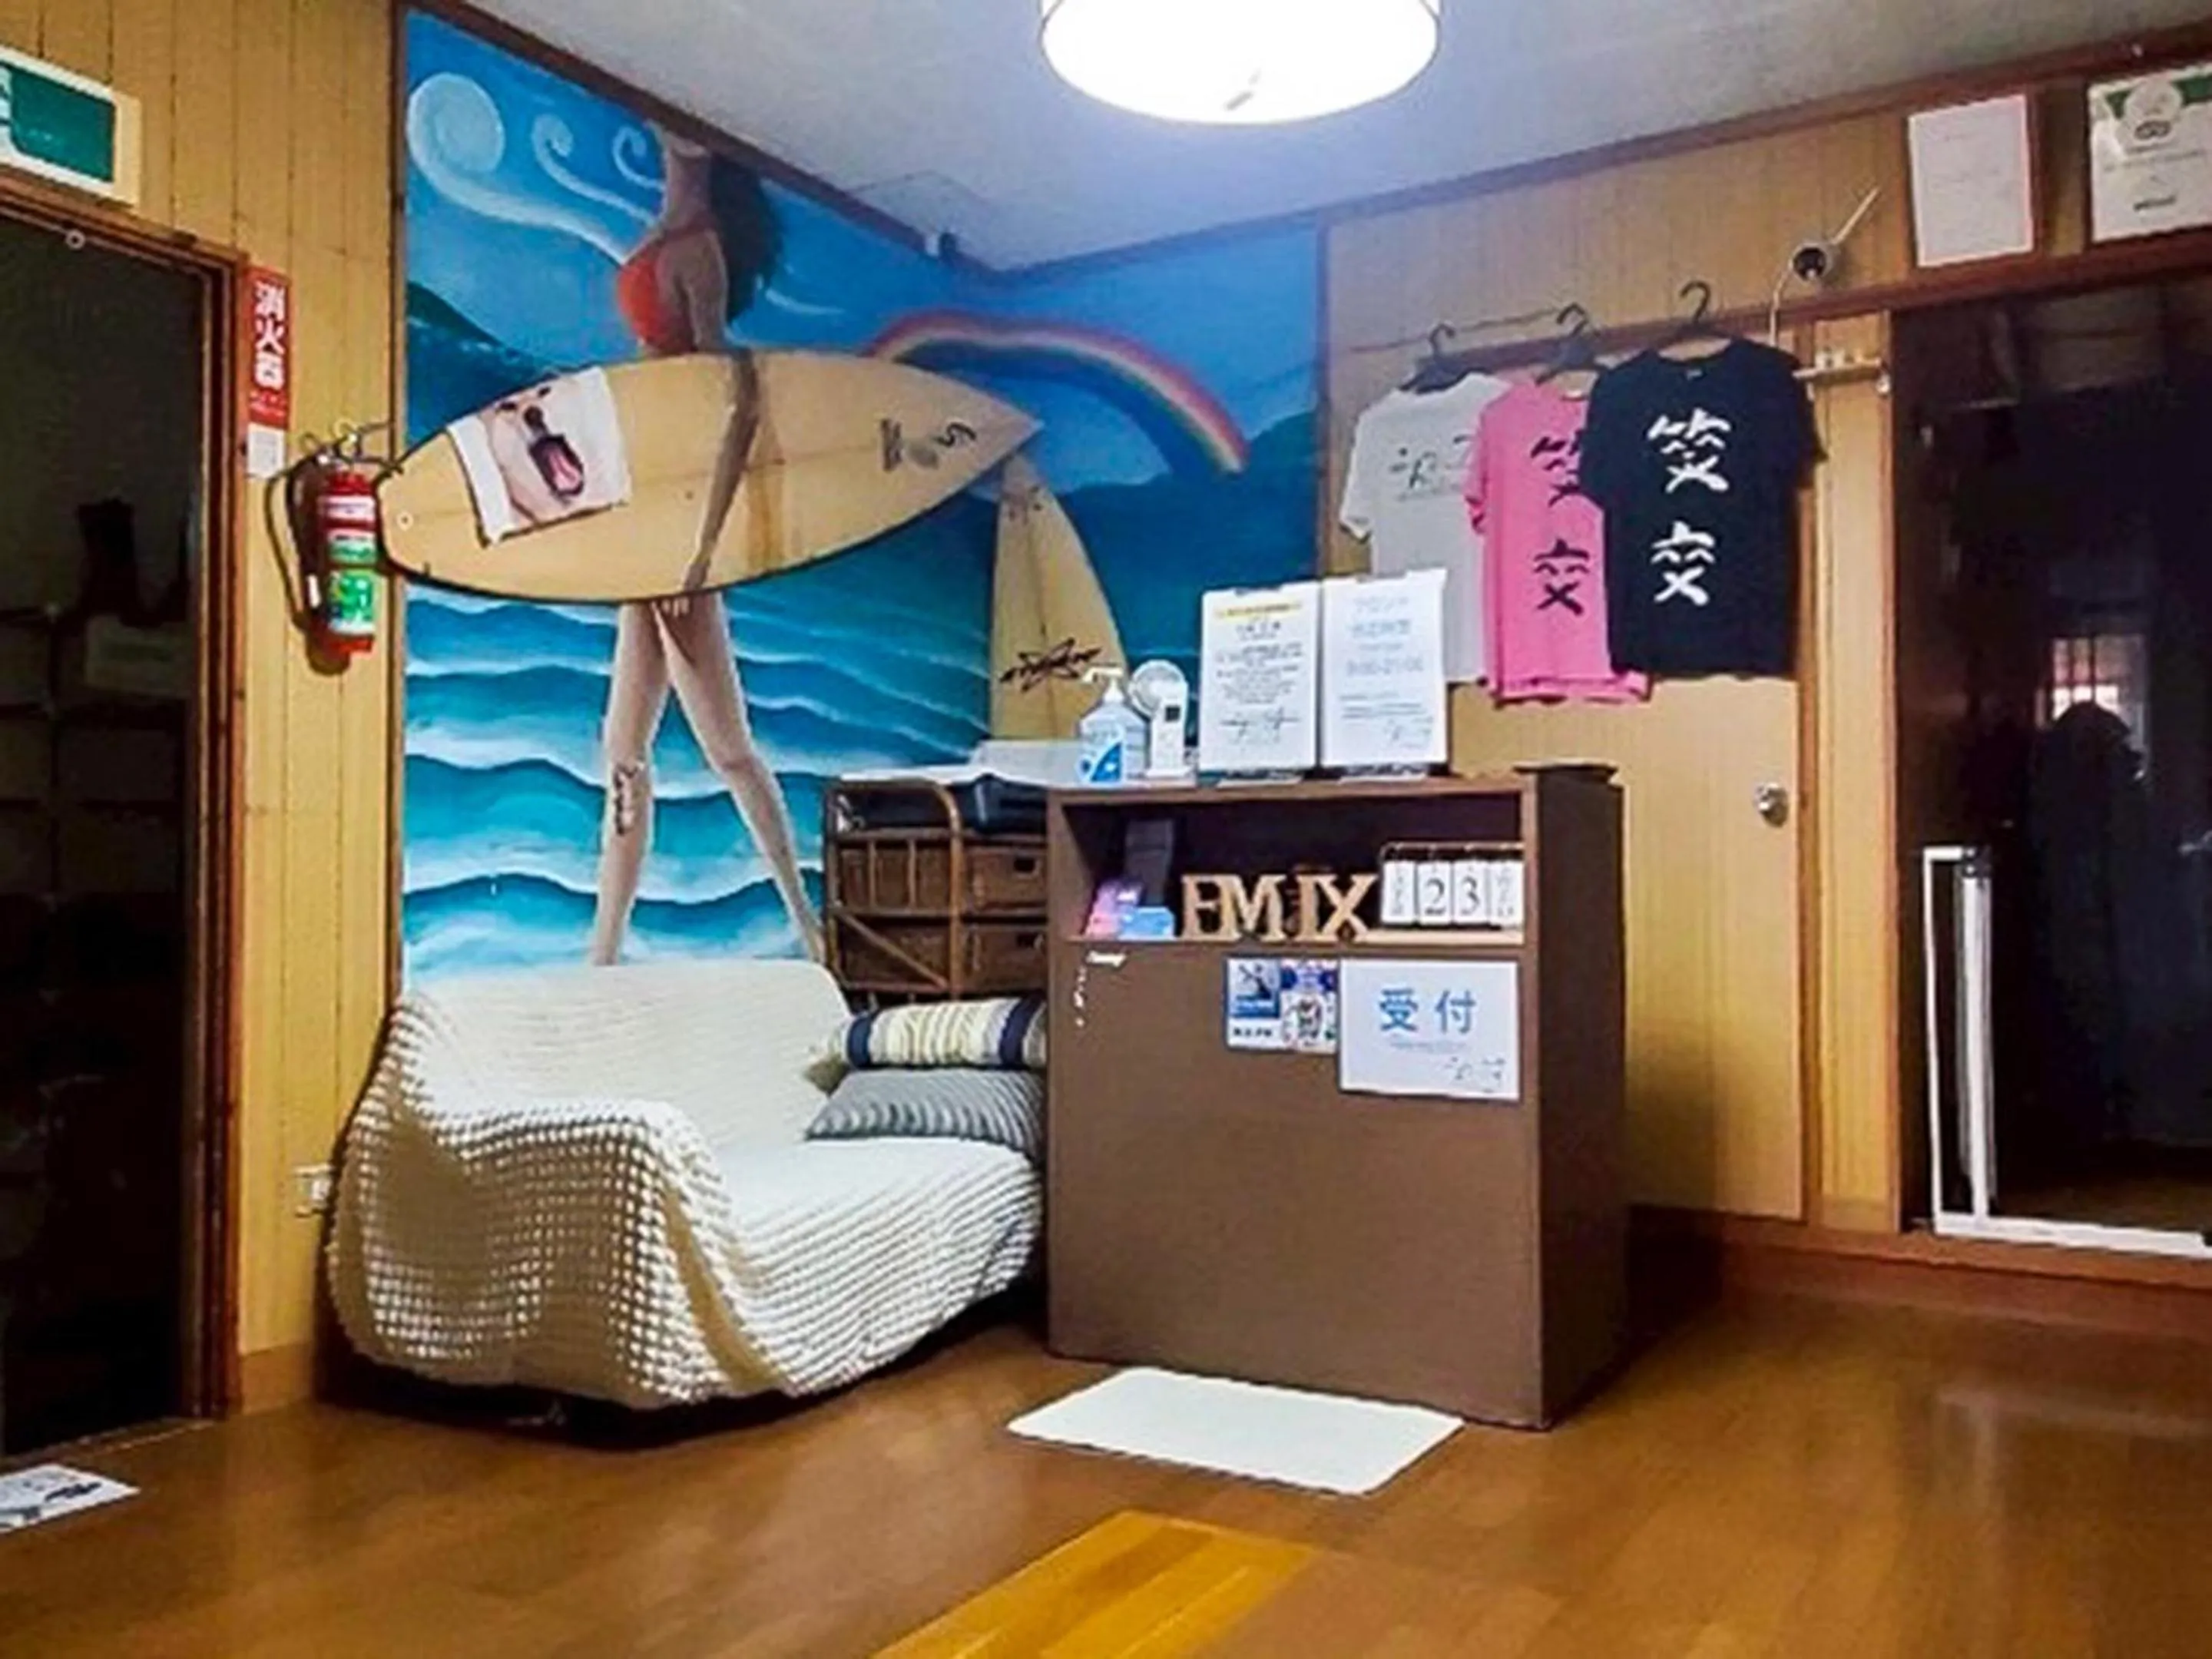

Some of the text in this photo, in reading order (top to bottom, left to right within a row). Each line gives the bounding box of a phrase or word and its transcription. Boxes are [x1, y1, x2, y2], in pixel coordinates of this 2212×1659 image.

[254, 279, 285, 390] 消火器
[1379, 988, 1478, 1035] 受付
